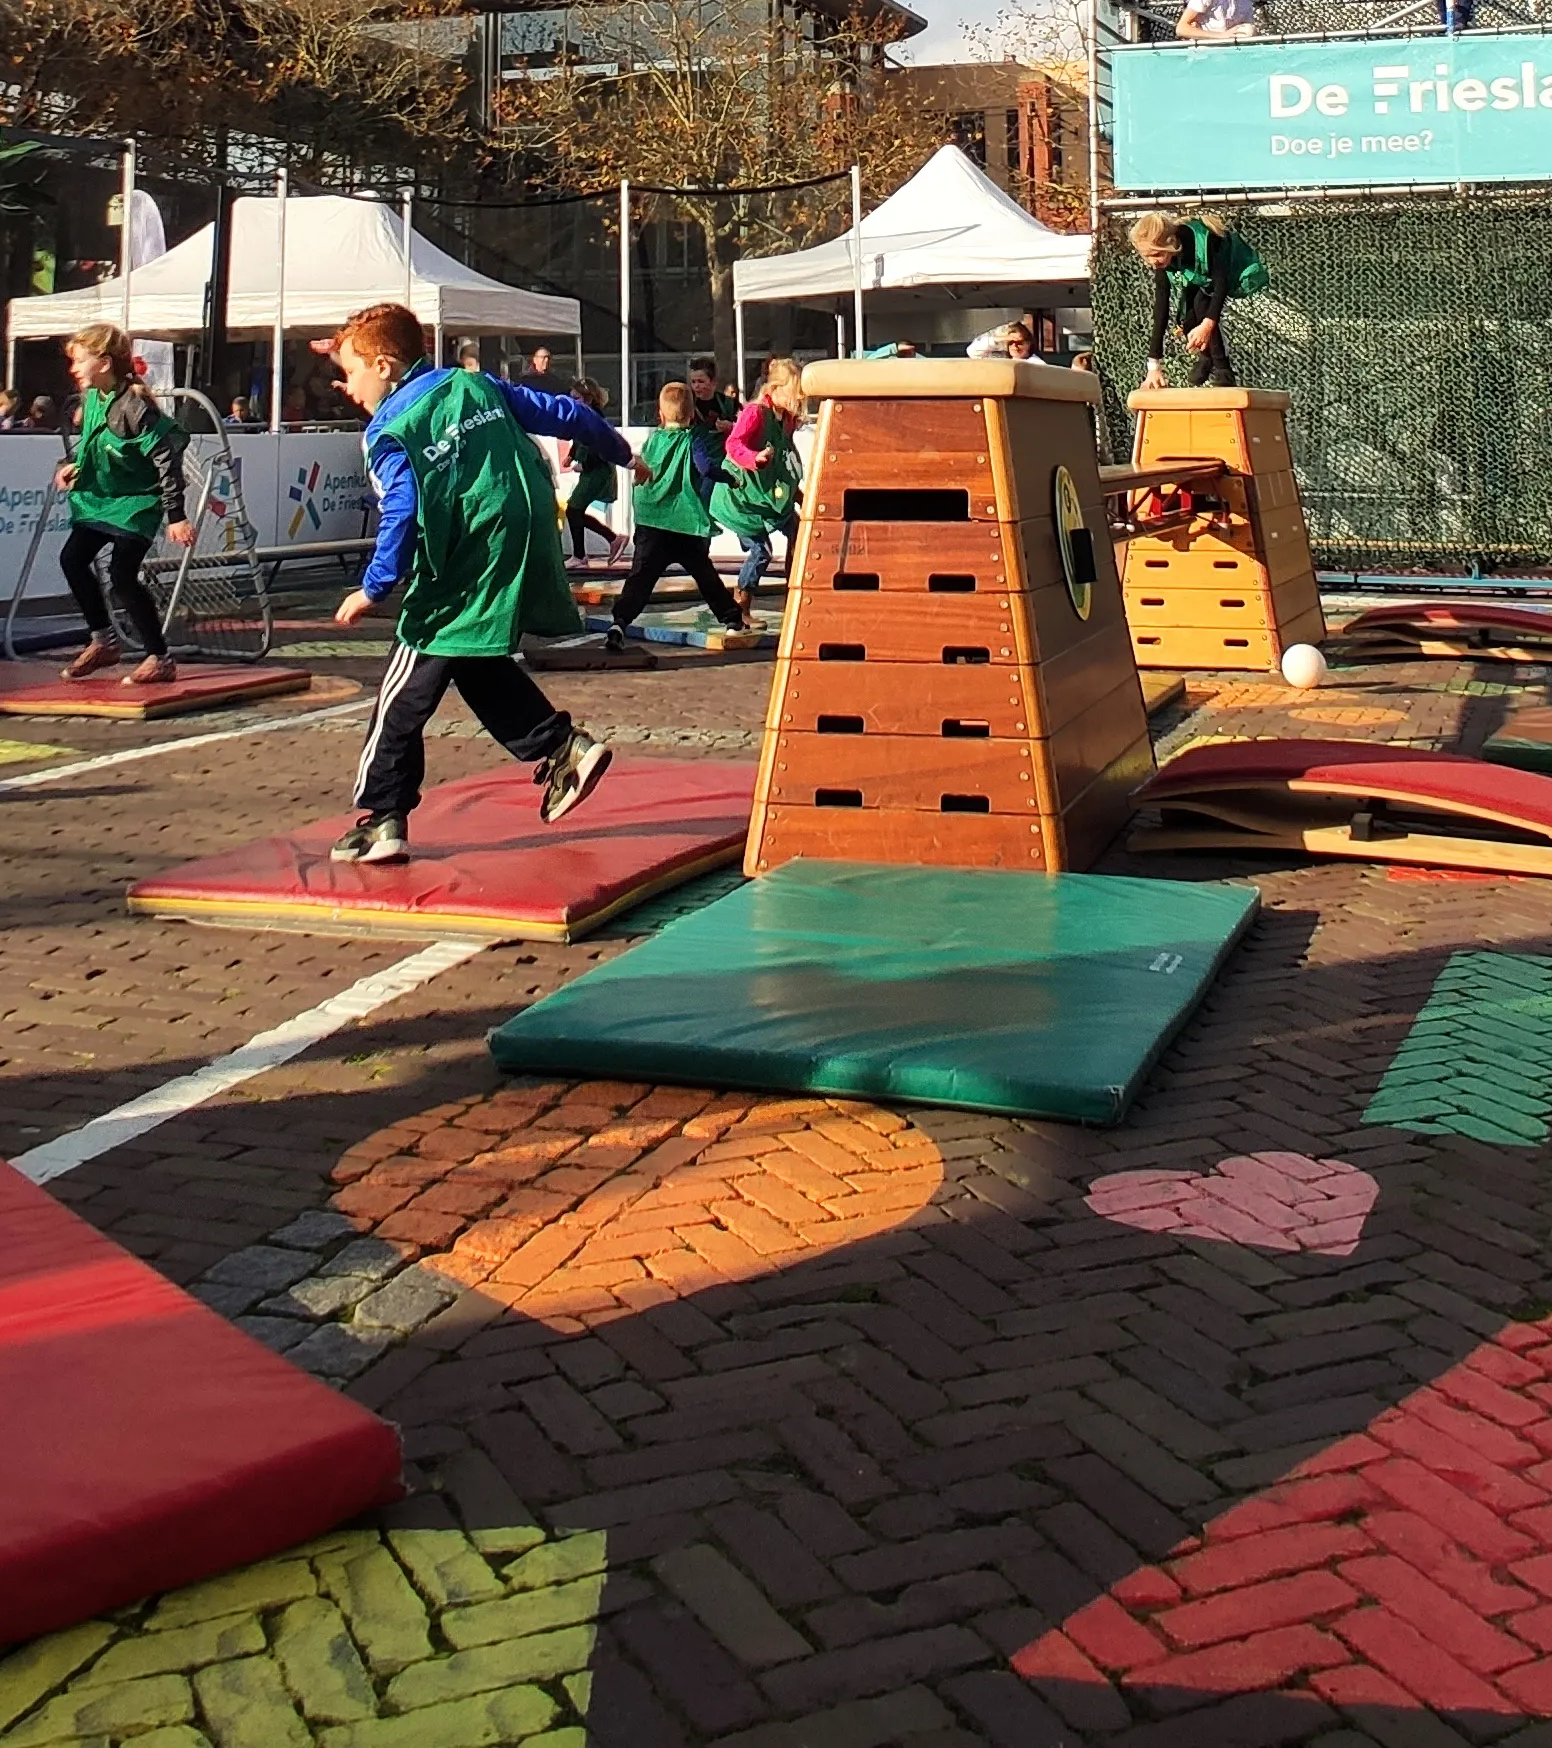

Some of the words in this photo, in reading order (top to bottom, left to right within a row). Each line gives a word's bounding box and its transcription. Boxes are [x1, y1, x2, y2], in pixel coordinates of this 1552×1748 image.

[1269, 73, 1348, 119] De
[1270, 134, 1323, 156] Doe
[1326, 131, 1353, 160] je
[1360, 129, 1433, 154] mee?
[423, 439, 451, 462] De
[323, 497, 335, 512] De
